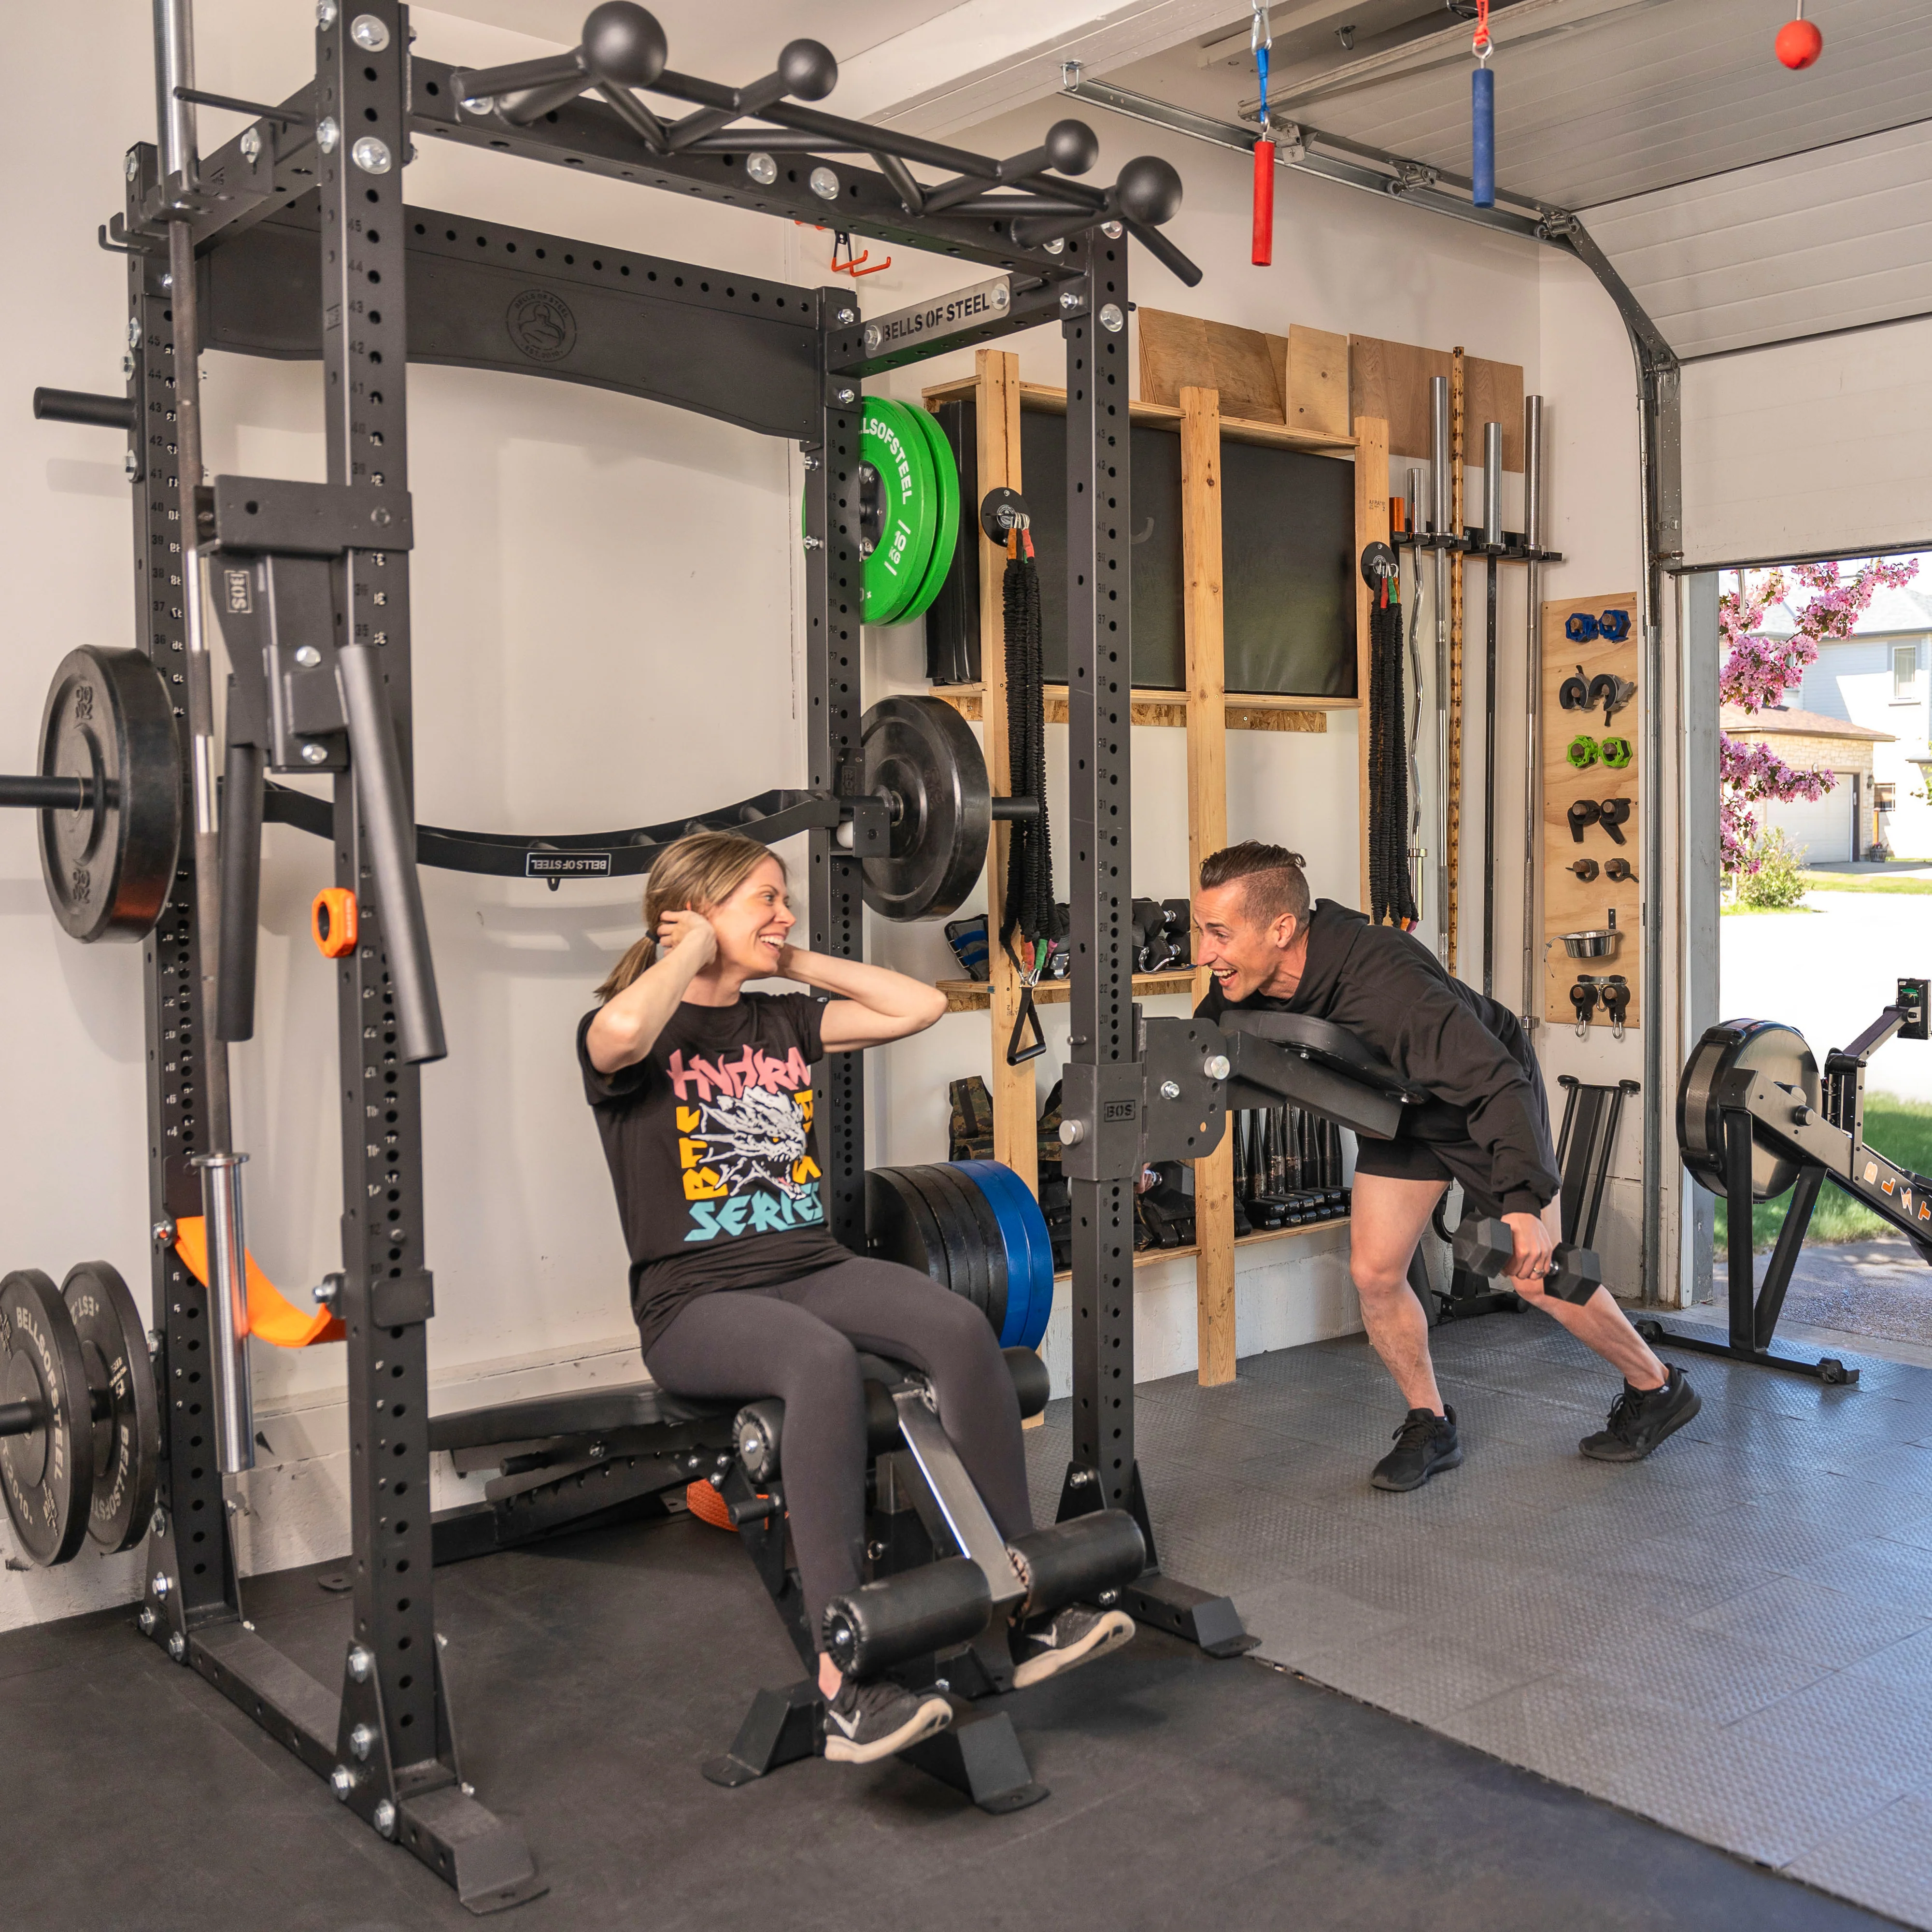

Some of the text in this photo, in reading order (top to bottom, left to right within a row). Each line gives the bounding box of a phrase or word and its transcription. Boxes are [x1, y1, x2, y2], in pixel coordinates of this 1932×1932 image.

[882, 293, 990, 342] BELLS OF STEEL
[149, 402, 161, 412] 43
[1096, 429, 1105, 439] 43
[150, 436, 162, 446] 42
[1097, 460, 1106, 469] 42
[150, 469, 162, 479] 41
[1097, 491, 1105, 500] 41
[151, 502, 164, 512] 40
[152, 535, 163, 545] 39
[894, 531, 907, 552] 10
[889, 546, 901, 565] KG
[230, 573, 247, 609] BOS
[153, 601, 165, 611] 37
[1097, 614, 1106, 624] 37
[154, 634, 165, 644] 36
[157, 667, 167, 677] 5
[1098, 707, 1106, 717] 34
[1098, 738, 1107, 748] 33
[1098, 768, 1107, 778] 32
[1099, 799, 1106, 809] 31
[1099, 830, 1107, 839] 30
[531, 859, 607, 870] BELLS OF STEEL
[1099, 953, 1108, 963] 24
[1099, 984, 1108, 994] 22
[1100, 1014, 1108, 1024] 20
[666, 1044, 811, 1102] HYDRA
[834, 1072, 840, 1081] 14
[1106, 1104, 1133, 1118] BOS
[683, 1181, 824, 1242] SERIES
[1104, 1335, 1108, 1344] 3
[1104, 1365, 1109, 1375] 2
[16, 1306, 63, 1480] BELLSOFSTEEL
[1104, 1395, 1108, 1405] 1
